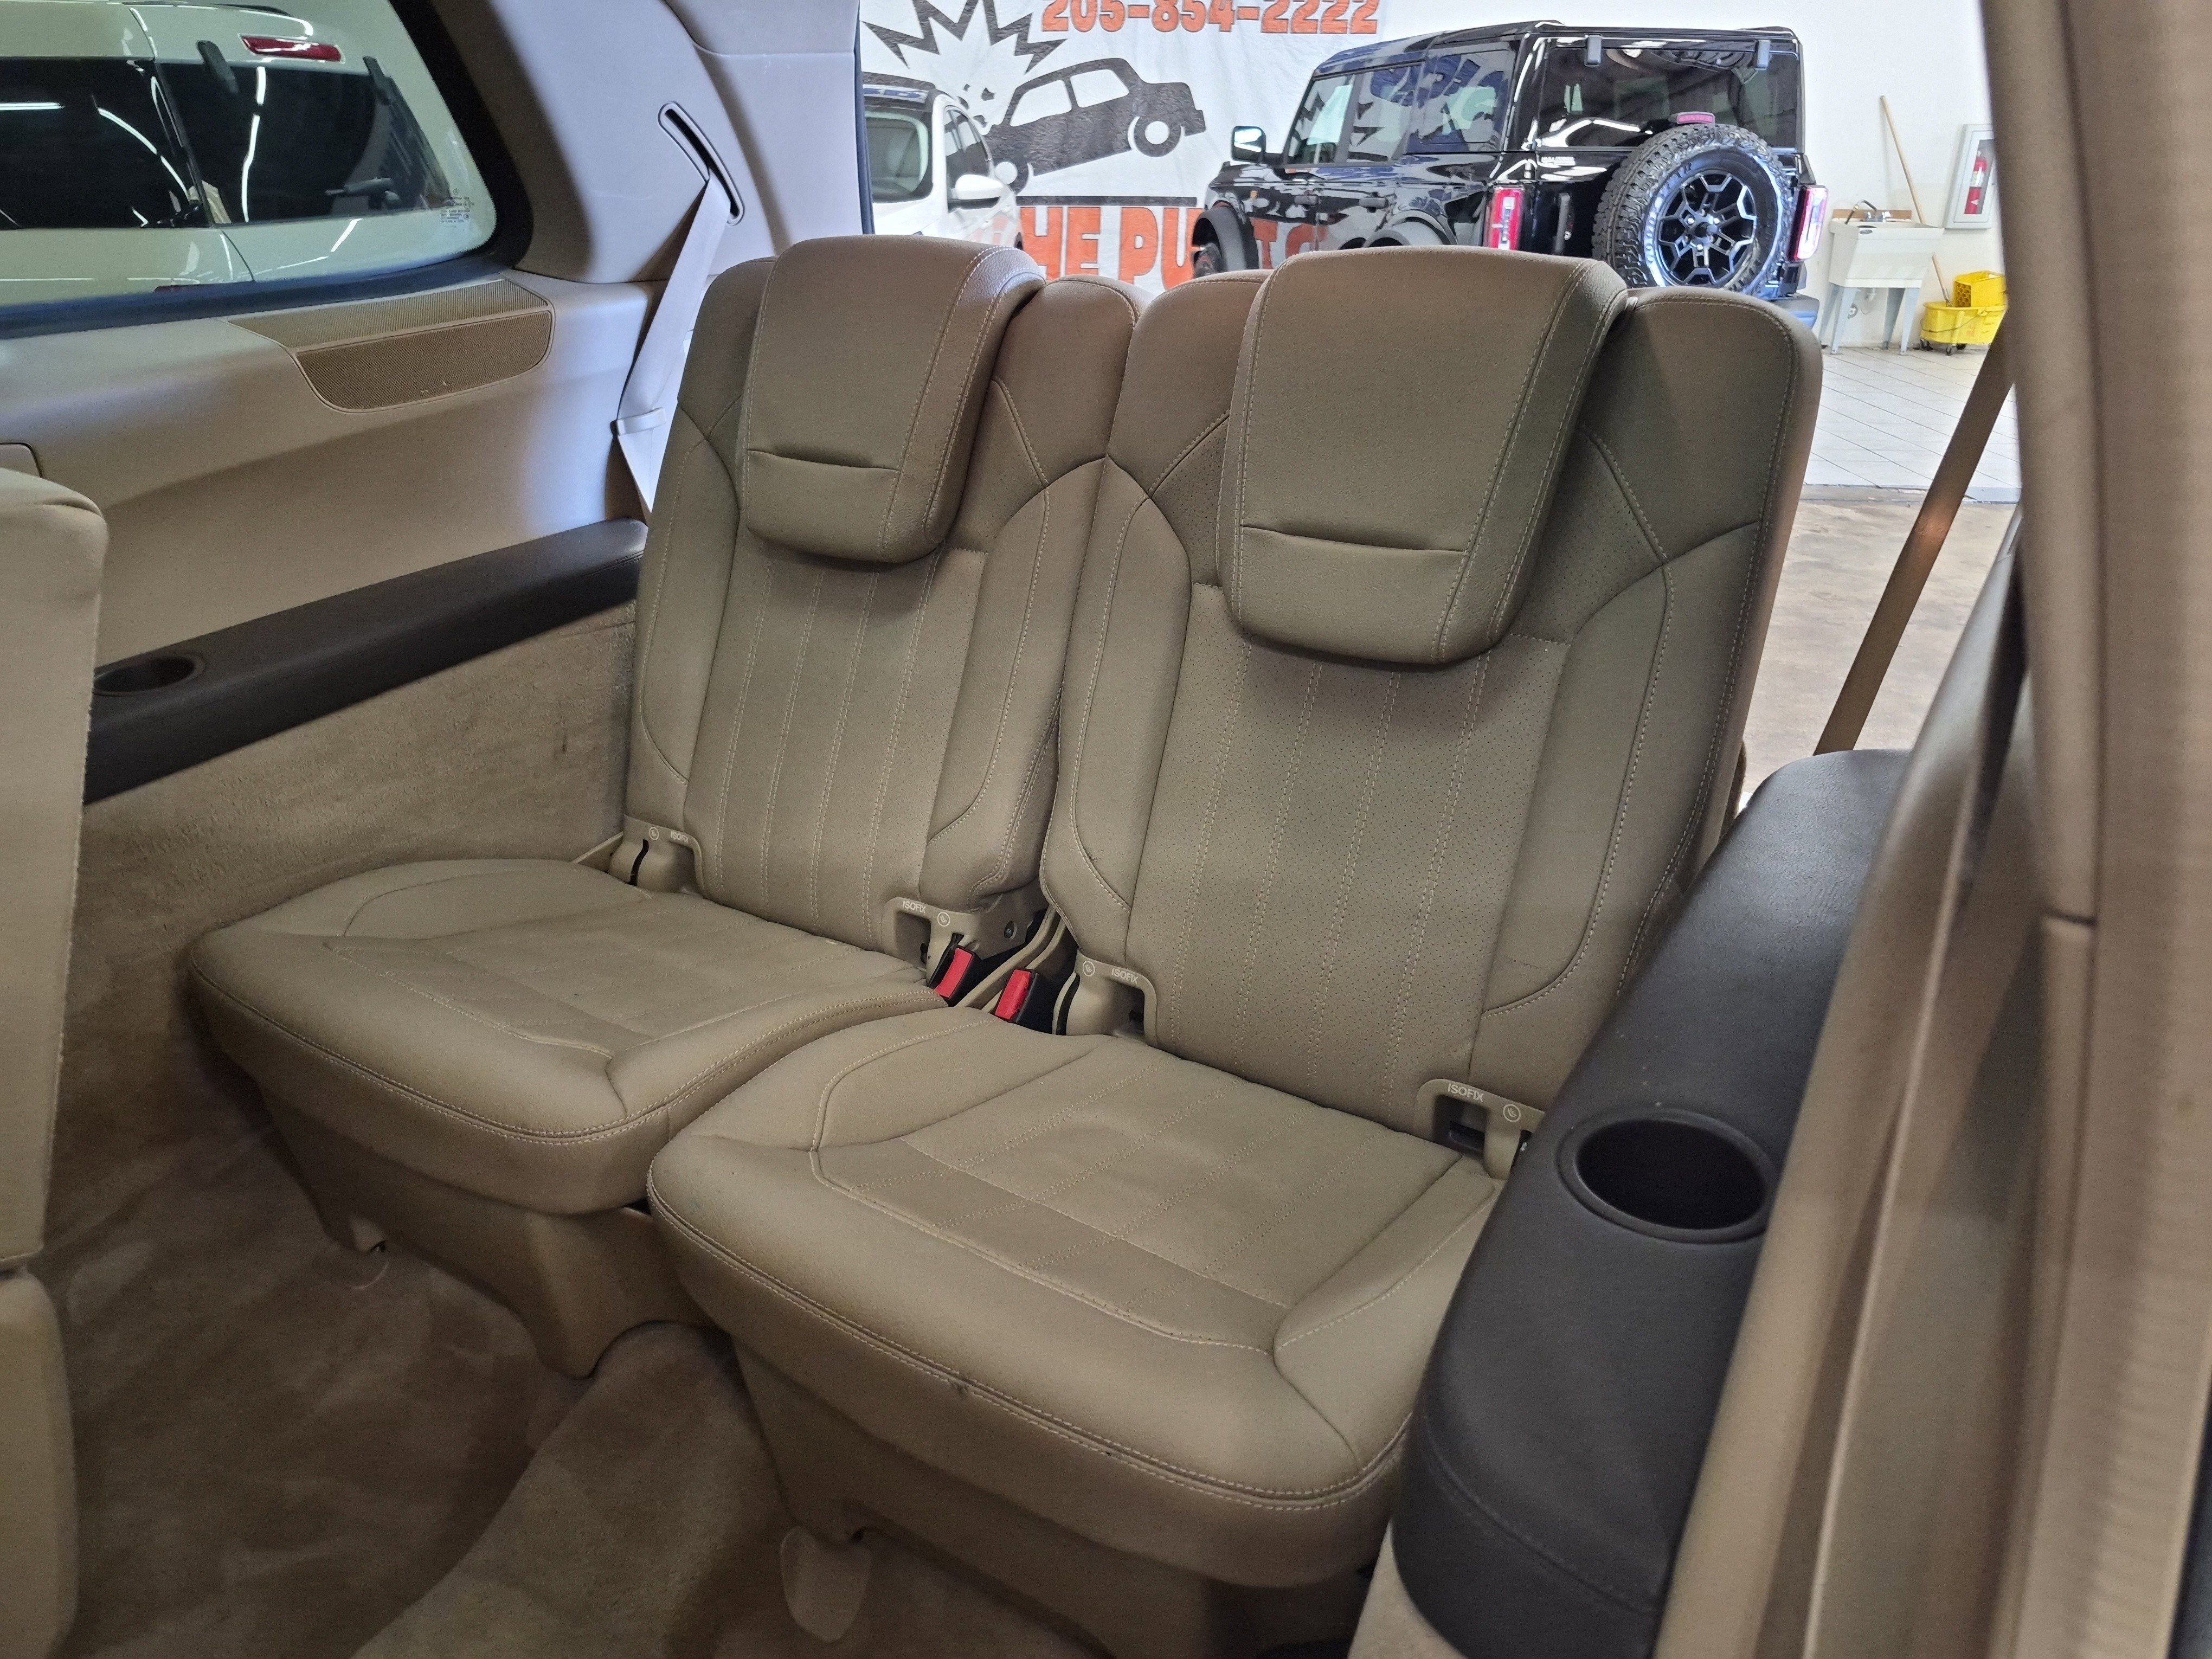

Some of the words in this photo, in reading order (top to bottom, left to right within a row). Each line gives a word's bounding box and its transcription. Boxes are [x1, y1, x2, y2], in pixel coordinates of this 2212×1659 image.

[1041, 0, 1378, 34] 205-854-2222
[1020, 207, 1101, 281] HE
[1119, 207, 1203, 291] PU
[670, 831, 689, 844] ISOFIX
[902, 900, 927, 914] ISOFIX
[1111, 967, 1139, 985] ISOFIX
[1448, 1083, 1483, 1103] ISOFIX
